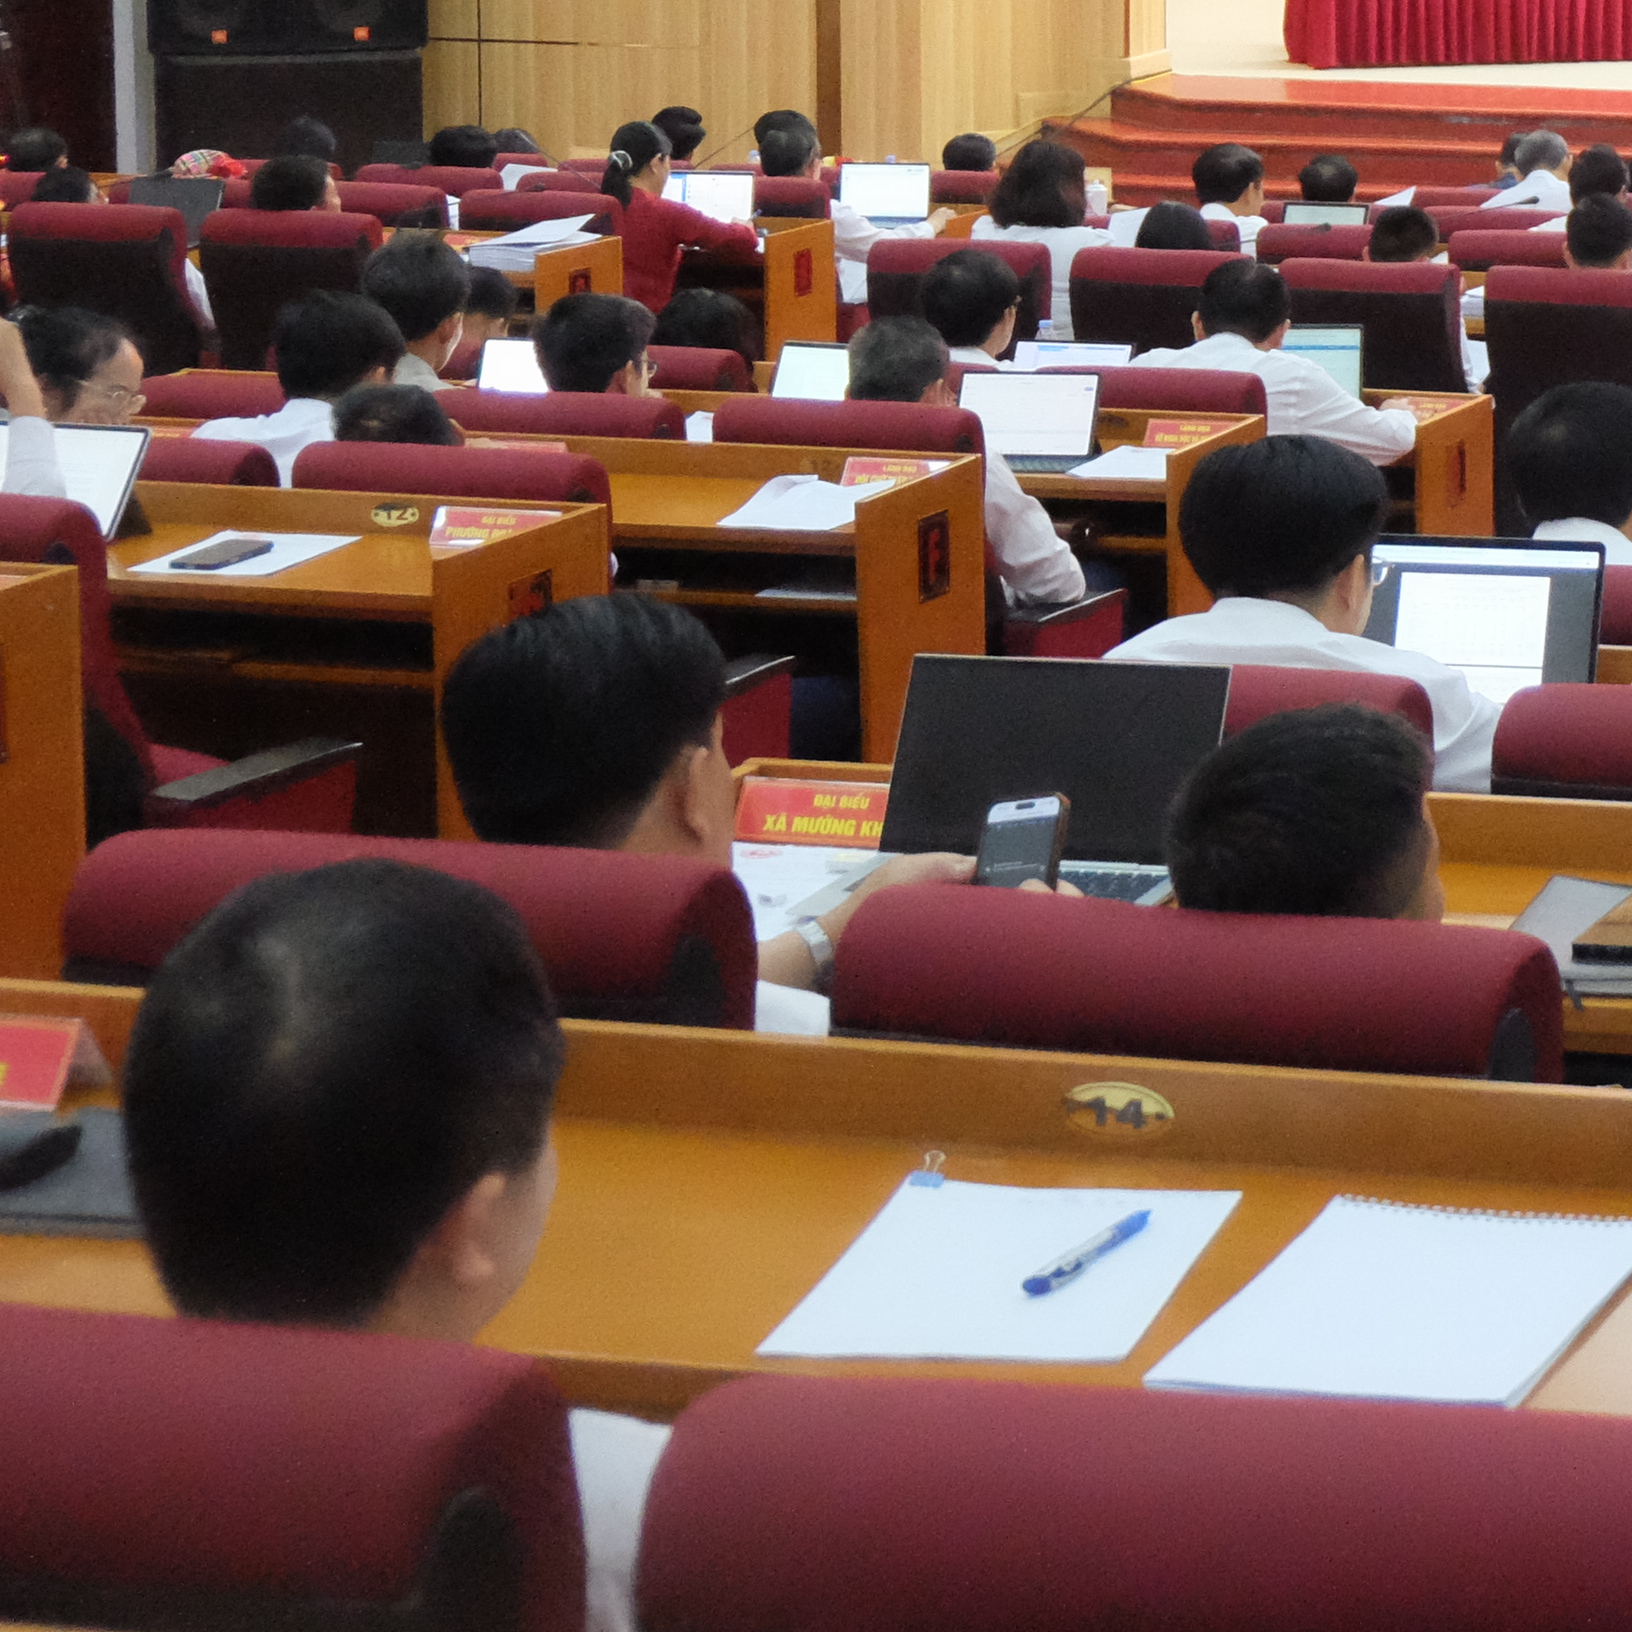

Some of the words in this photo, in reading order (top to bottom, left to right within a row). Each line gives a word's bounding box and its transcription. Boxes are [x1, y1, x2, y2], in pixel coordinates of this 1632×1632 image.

[813, 793, 837, 811] ĐẠI
[839, 792, 870, 810] BIỂU
[763, 812, 788, 832] XÃ
[1087, 1095, 1146, 1130] 14
